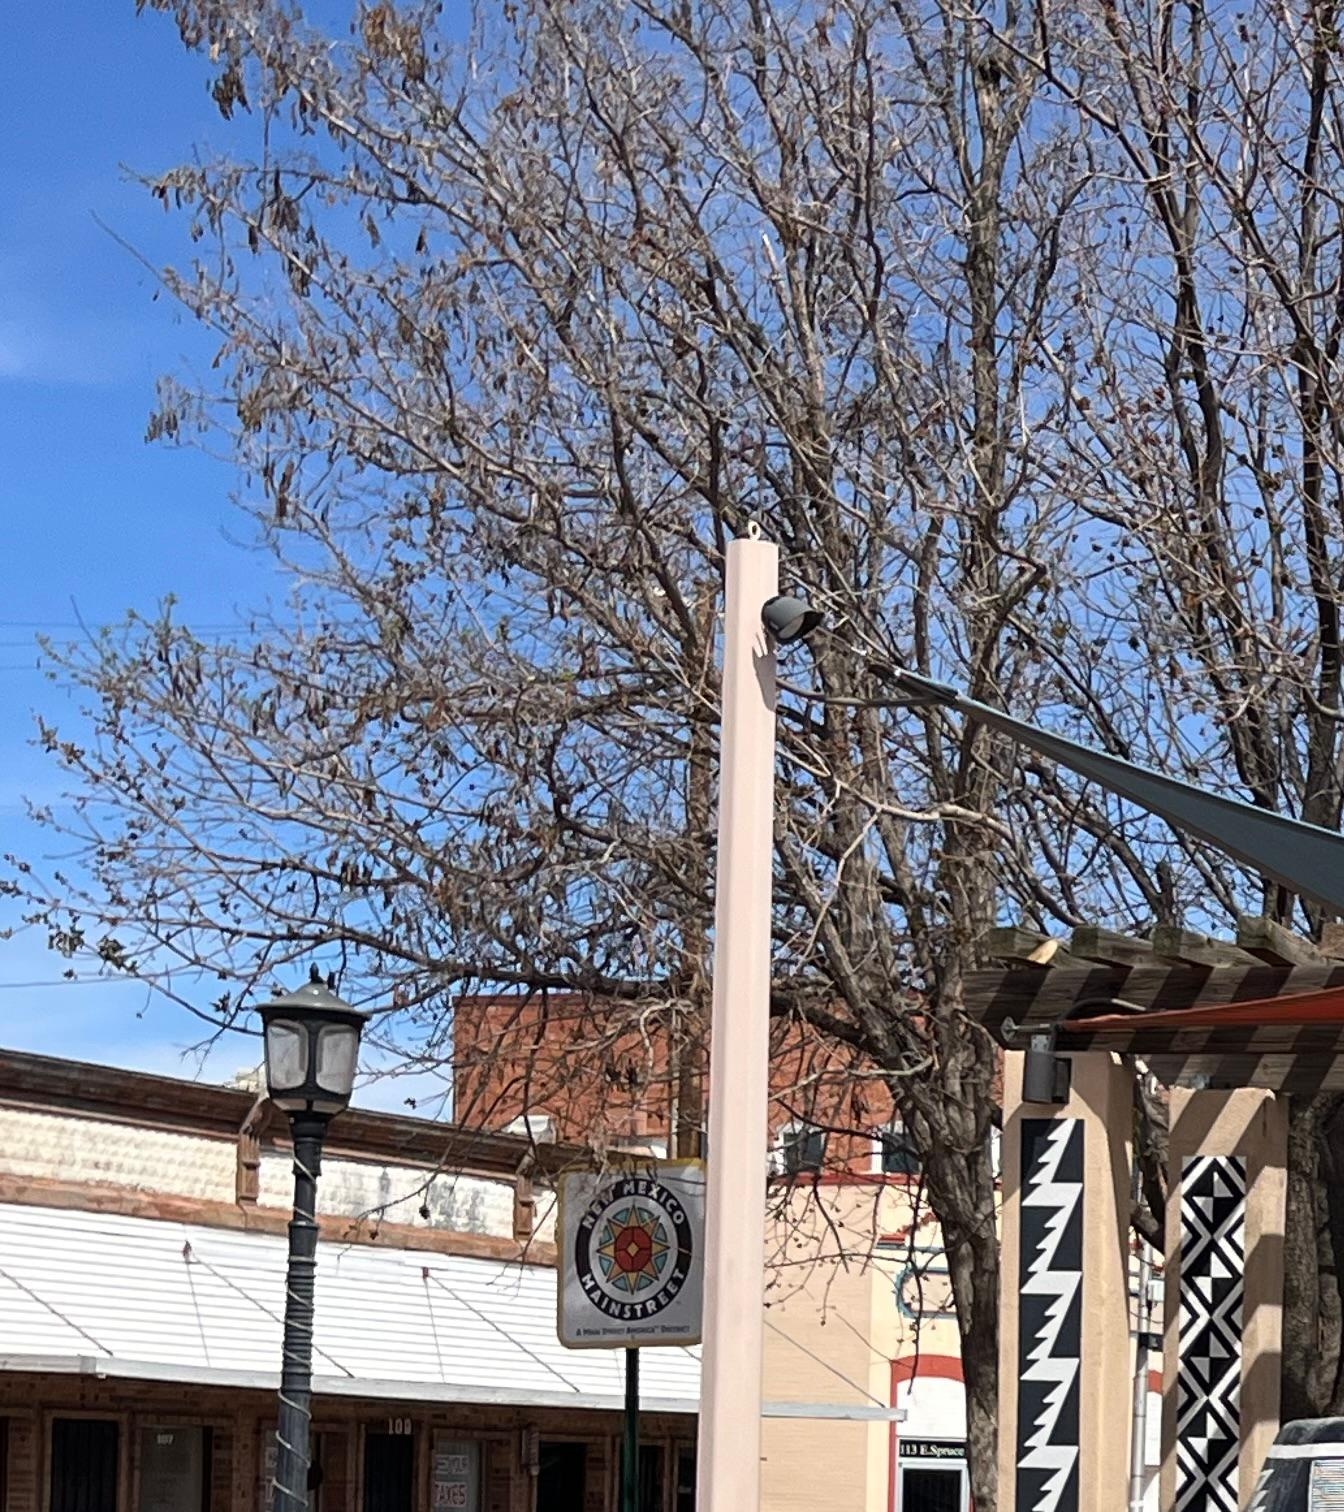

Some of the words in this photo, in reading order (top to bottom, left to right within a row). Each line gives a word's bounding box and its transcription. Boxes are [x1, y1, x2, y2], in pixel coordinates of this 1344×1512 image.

[623, 1181, 685, 1224] MEXICO
[581, 1268, 685, 1318] MAINSTREET
[900, 1443, 918, 1456] 113
